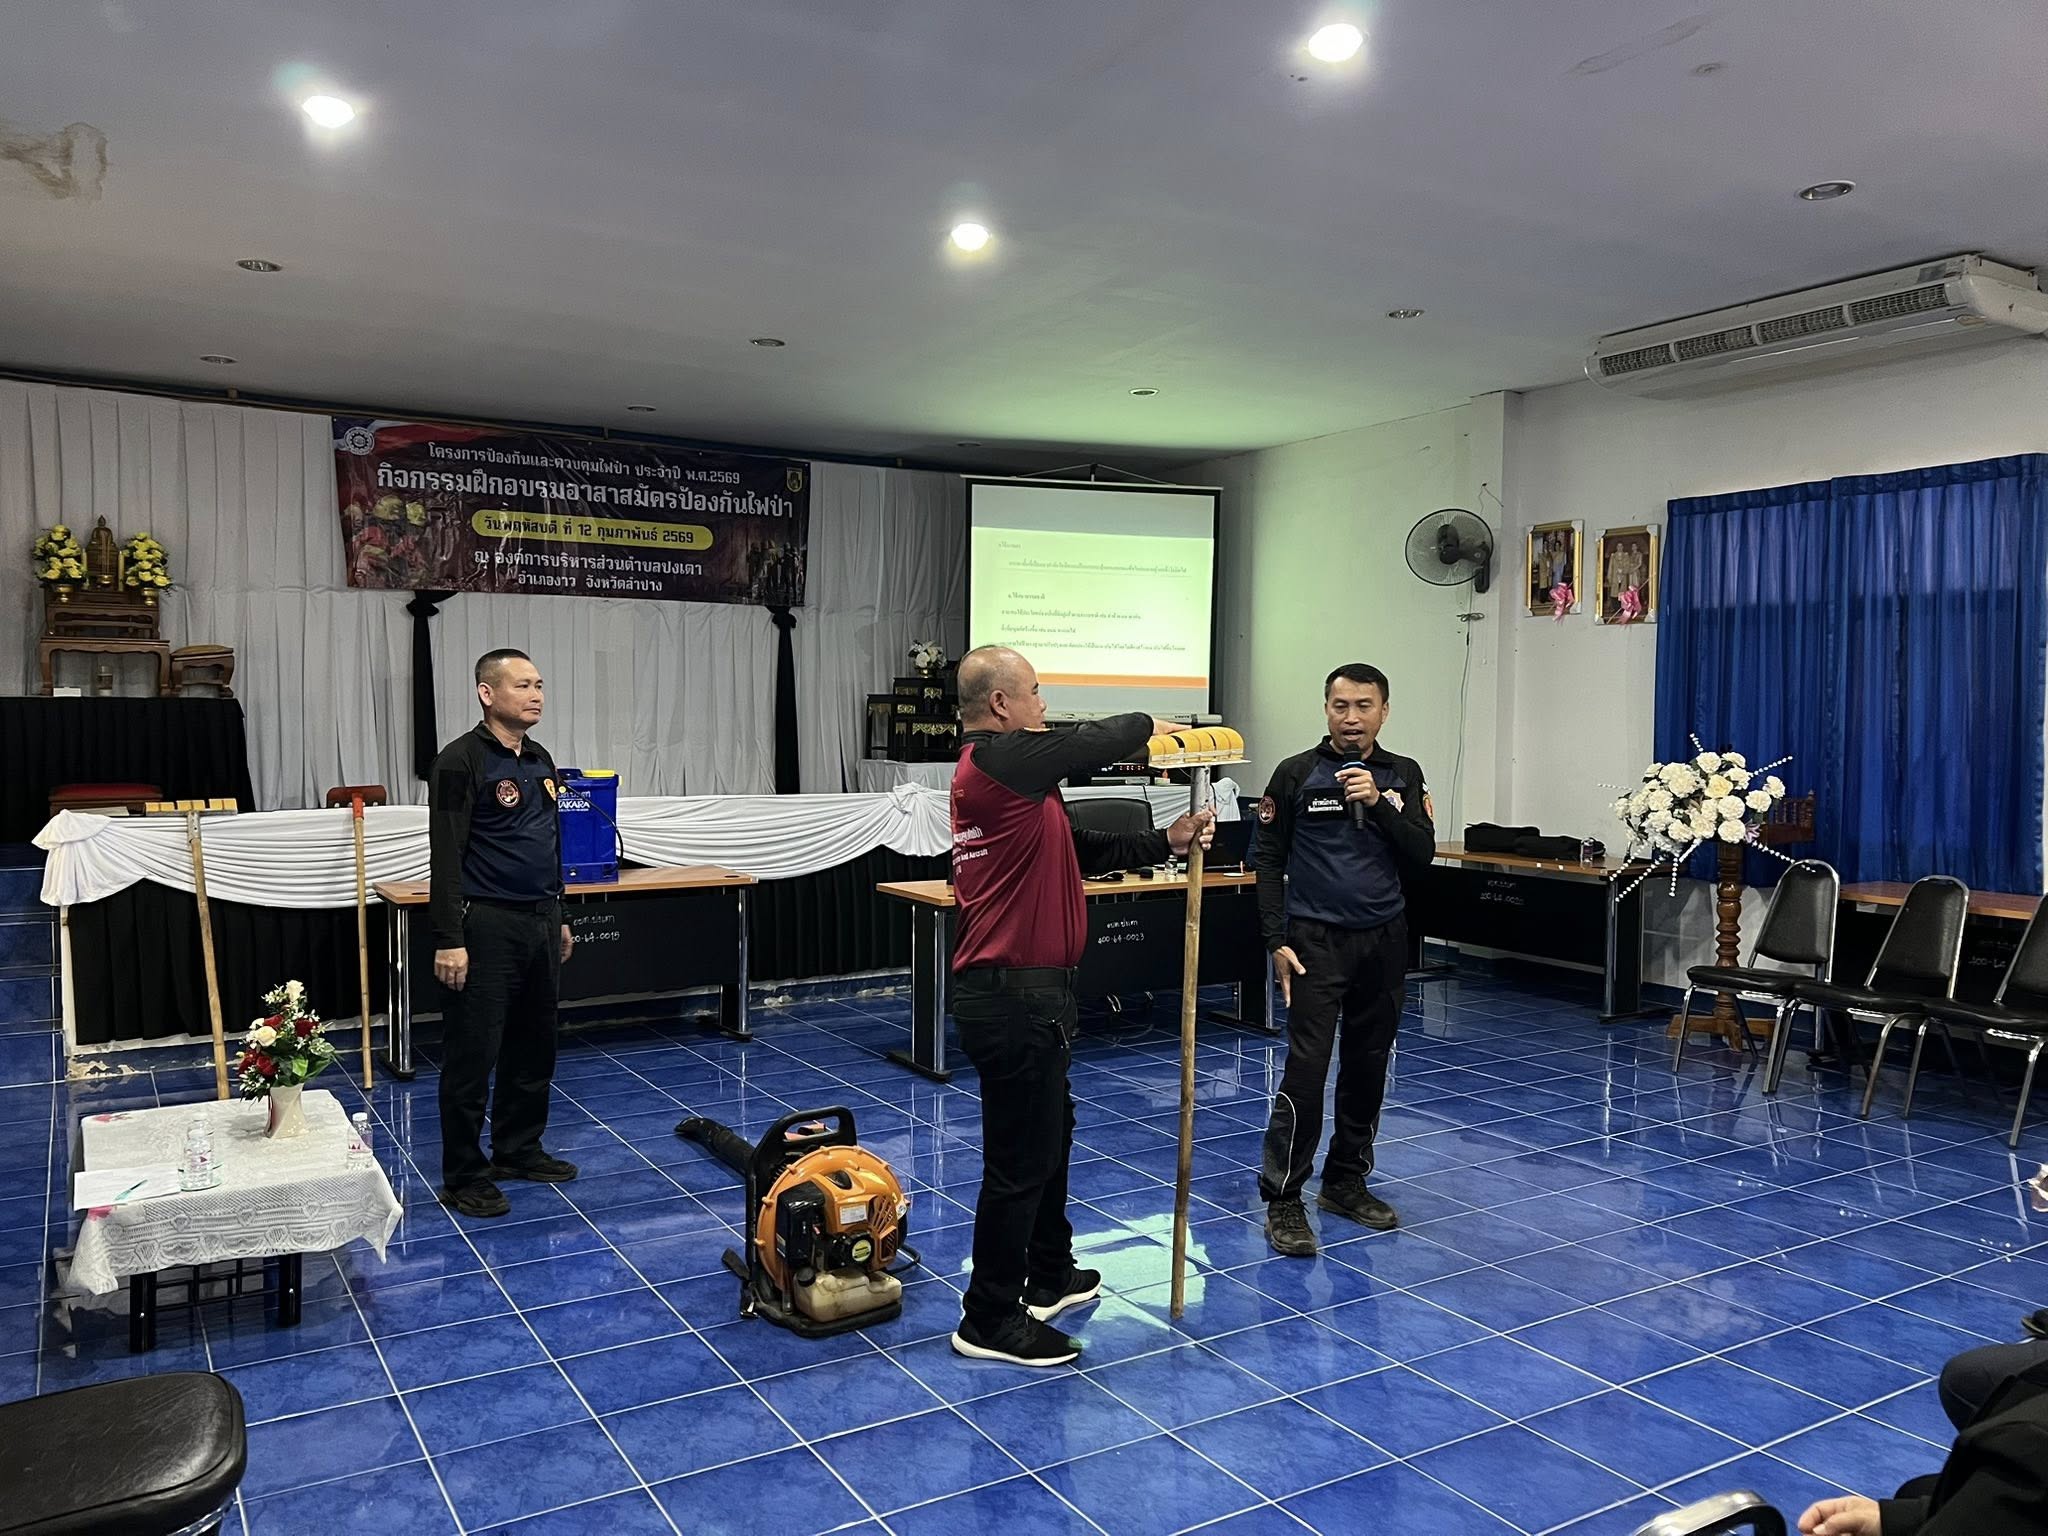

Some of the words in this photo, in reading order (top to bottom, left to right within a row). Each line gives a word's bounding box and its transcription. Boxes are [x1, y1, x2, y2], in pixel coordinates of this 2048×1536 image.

[428, 442, 630, 476] โครงการป้องกันและควบคุมไฟป่า
[635, 465, 681, 480] ประจำปี
[685, 470, 740, 485] พ.ศ.2569
[377, 461, 793, 518] กิจกรรมฝึกอบรมอาสาสมัครป้องกันไฟป่า
[484, 516, 558, 535] วันพฤหัสบดี
[563, 517, 572, 535] ที่
[577, 524, 592, 537] 12
[597, 527, 657, 543] กุมภาพันธ์
[662, 530, 694, 544] 2569
[517, 572, 576, 587] อำเภองาว
[586, 574, 662, 592] จังหวัดลำปาง
